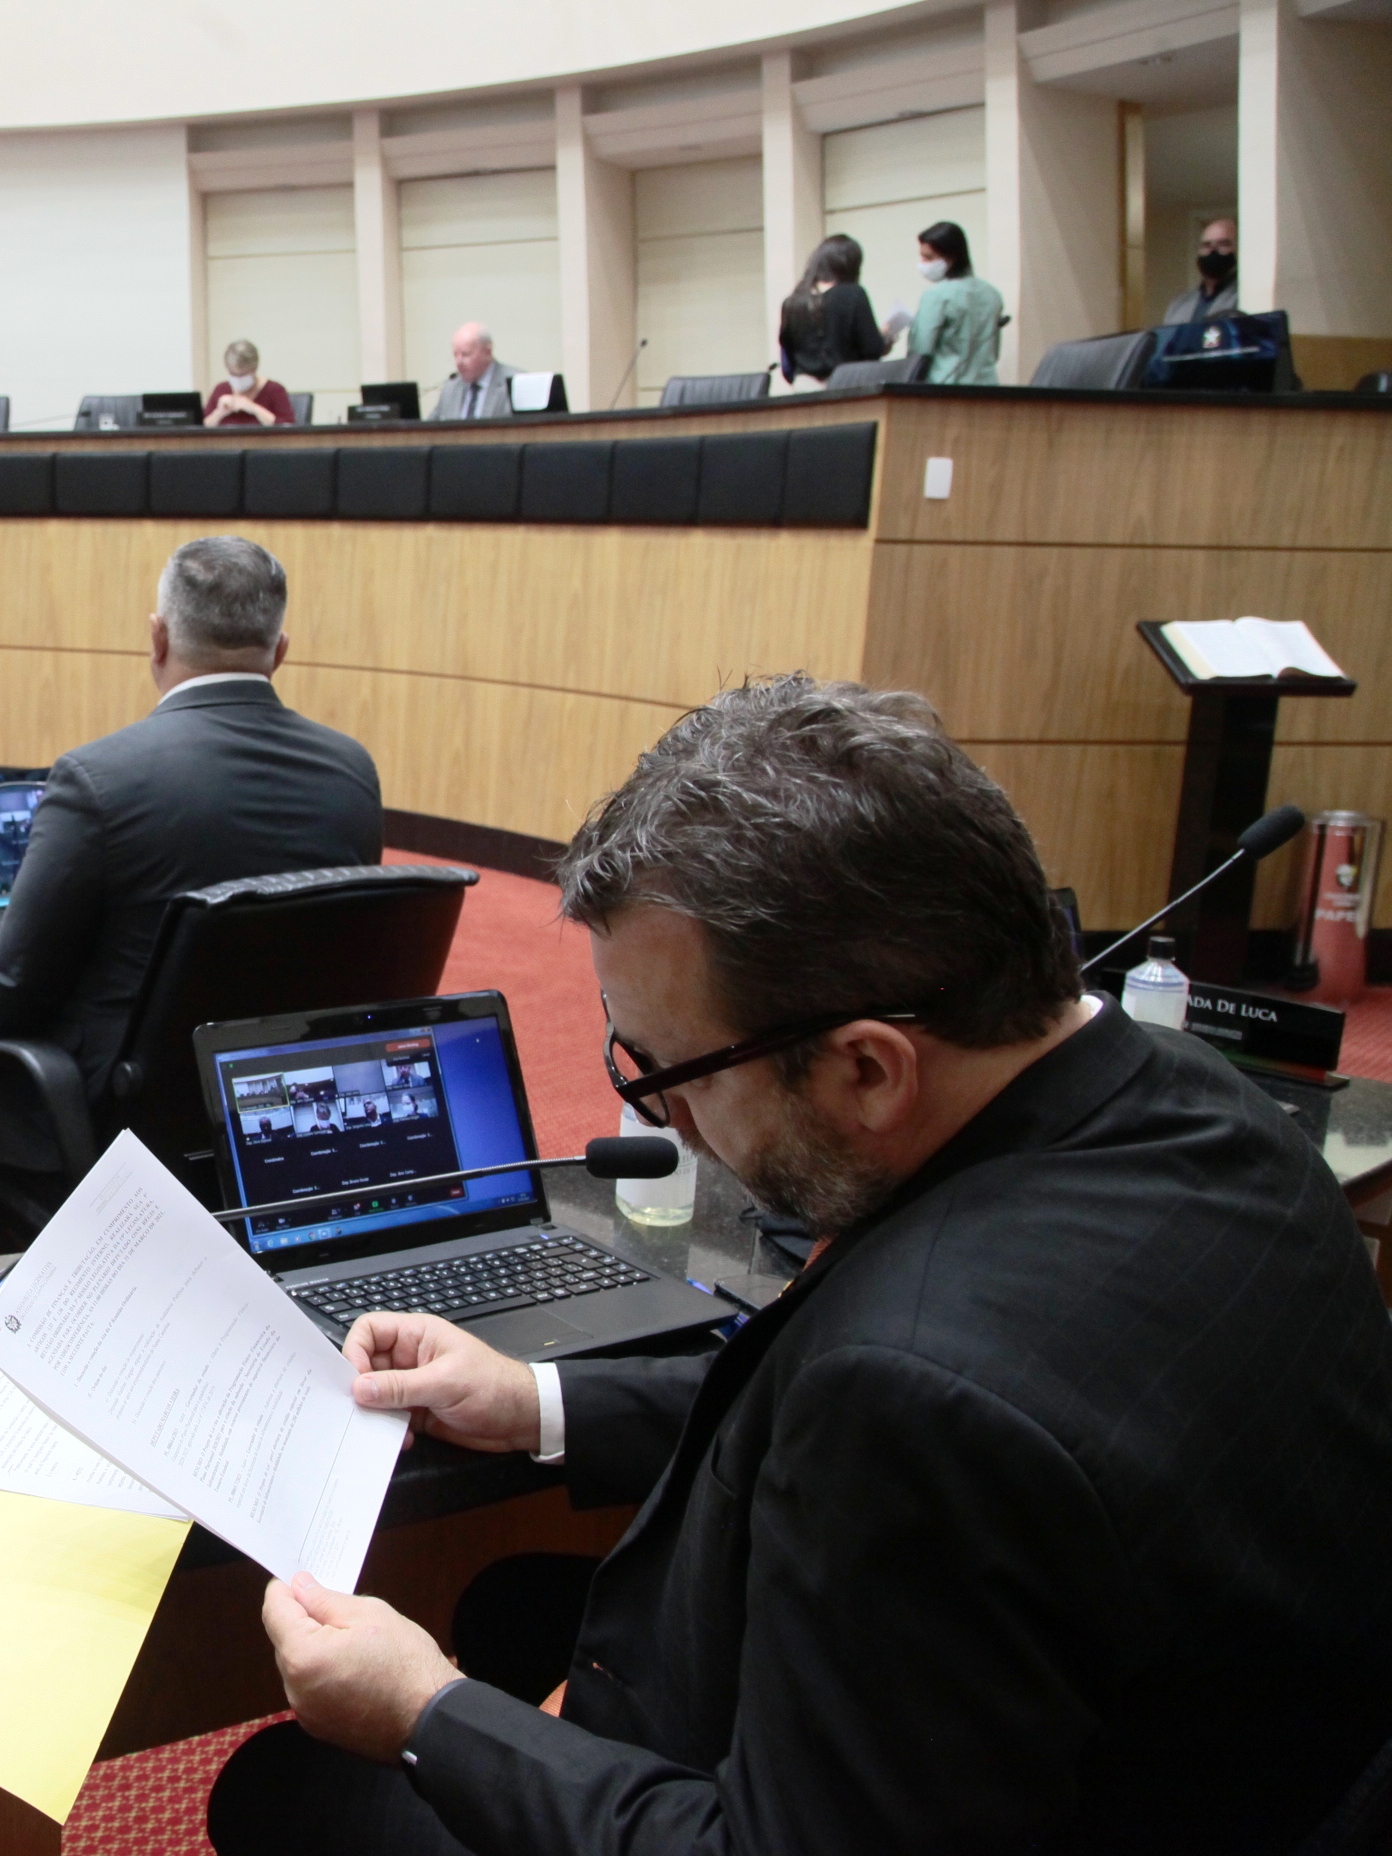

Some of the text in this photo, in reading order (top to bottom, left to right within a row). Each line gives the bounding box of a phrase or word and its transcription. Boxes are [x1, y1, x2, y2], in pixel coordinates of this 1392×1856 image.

[1217, 999, 1236, 1015] DE
[1240, 1003, 1278, 1022] LUCA
[29, 1316, 47, 1343] COMISSÃO
[45, 1308, 52, 1317] DE
[50, 1284, 69, 1309] FINANÇAS
[95, 1235, 103, 1245] EM
[102, 1198, 134, 1235] CUMPRIMENTO
[133, 1186, 143, 1198] AOS
[32, 1331, 48, 1354] ARTIGOS
[62, 1297, 70, 1306] DO
[68, 1266, 91, 1296] REGIMENTO
[109, 1211, 133, 1240] REALIZARÁ
[133, 1199, 143, 1210] SUA
[39, 1337, 54, 1359] REUNIÃO
[52, 1310, 71, 1338] ORDINÁRIA
[68, 1303, 76, 1312] DA
[77, 1280, 91, 1299] SESSÃO
[89, 1248, 114, 1281] LEGISLATIVA
[112, 1240, 120, 1249] DA
[45, 1338, 63, 1364] AGENDADA
[62, 1324, 72, 1338] PARA
[70, 1300, 88, 1324] OCORRER
[86, 1291, 94, 1300] NO
[92, 1265, 111, 1292] PLENÁRIO
[109, 1238, 131, 1266] DEPUTADO
[130, 1225, 142, 1239] OSNI
[141, 1208, 155, 1225] RÉGIS
[52, 1359, 61, 1370] POR
[99, 1276, 113, 1295] HORAS
[110, 1269, 118, 1278] DO
[116, 1260, 125, 1270] DIA
[127, 1247, 135, 1255] DE
[133, 1228, 150, 1248] MARÇO
[148, 1221, 155, 1230] DE
[110, 1305, 123, 1323] Reunião
[59, 1364, 68, 1376] COM
[68, 1336, 85, 1361] SEGUINTE
[160, 1402, 173, 1423] MARCOS
